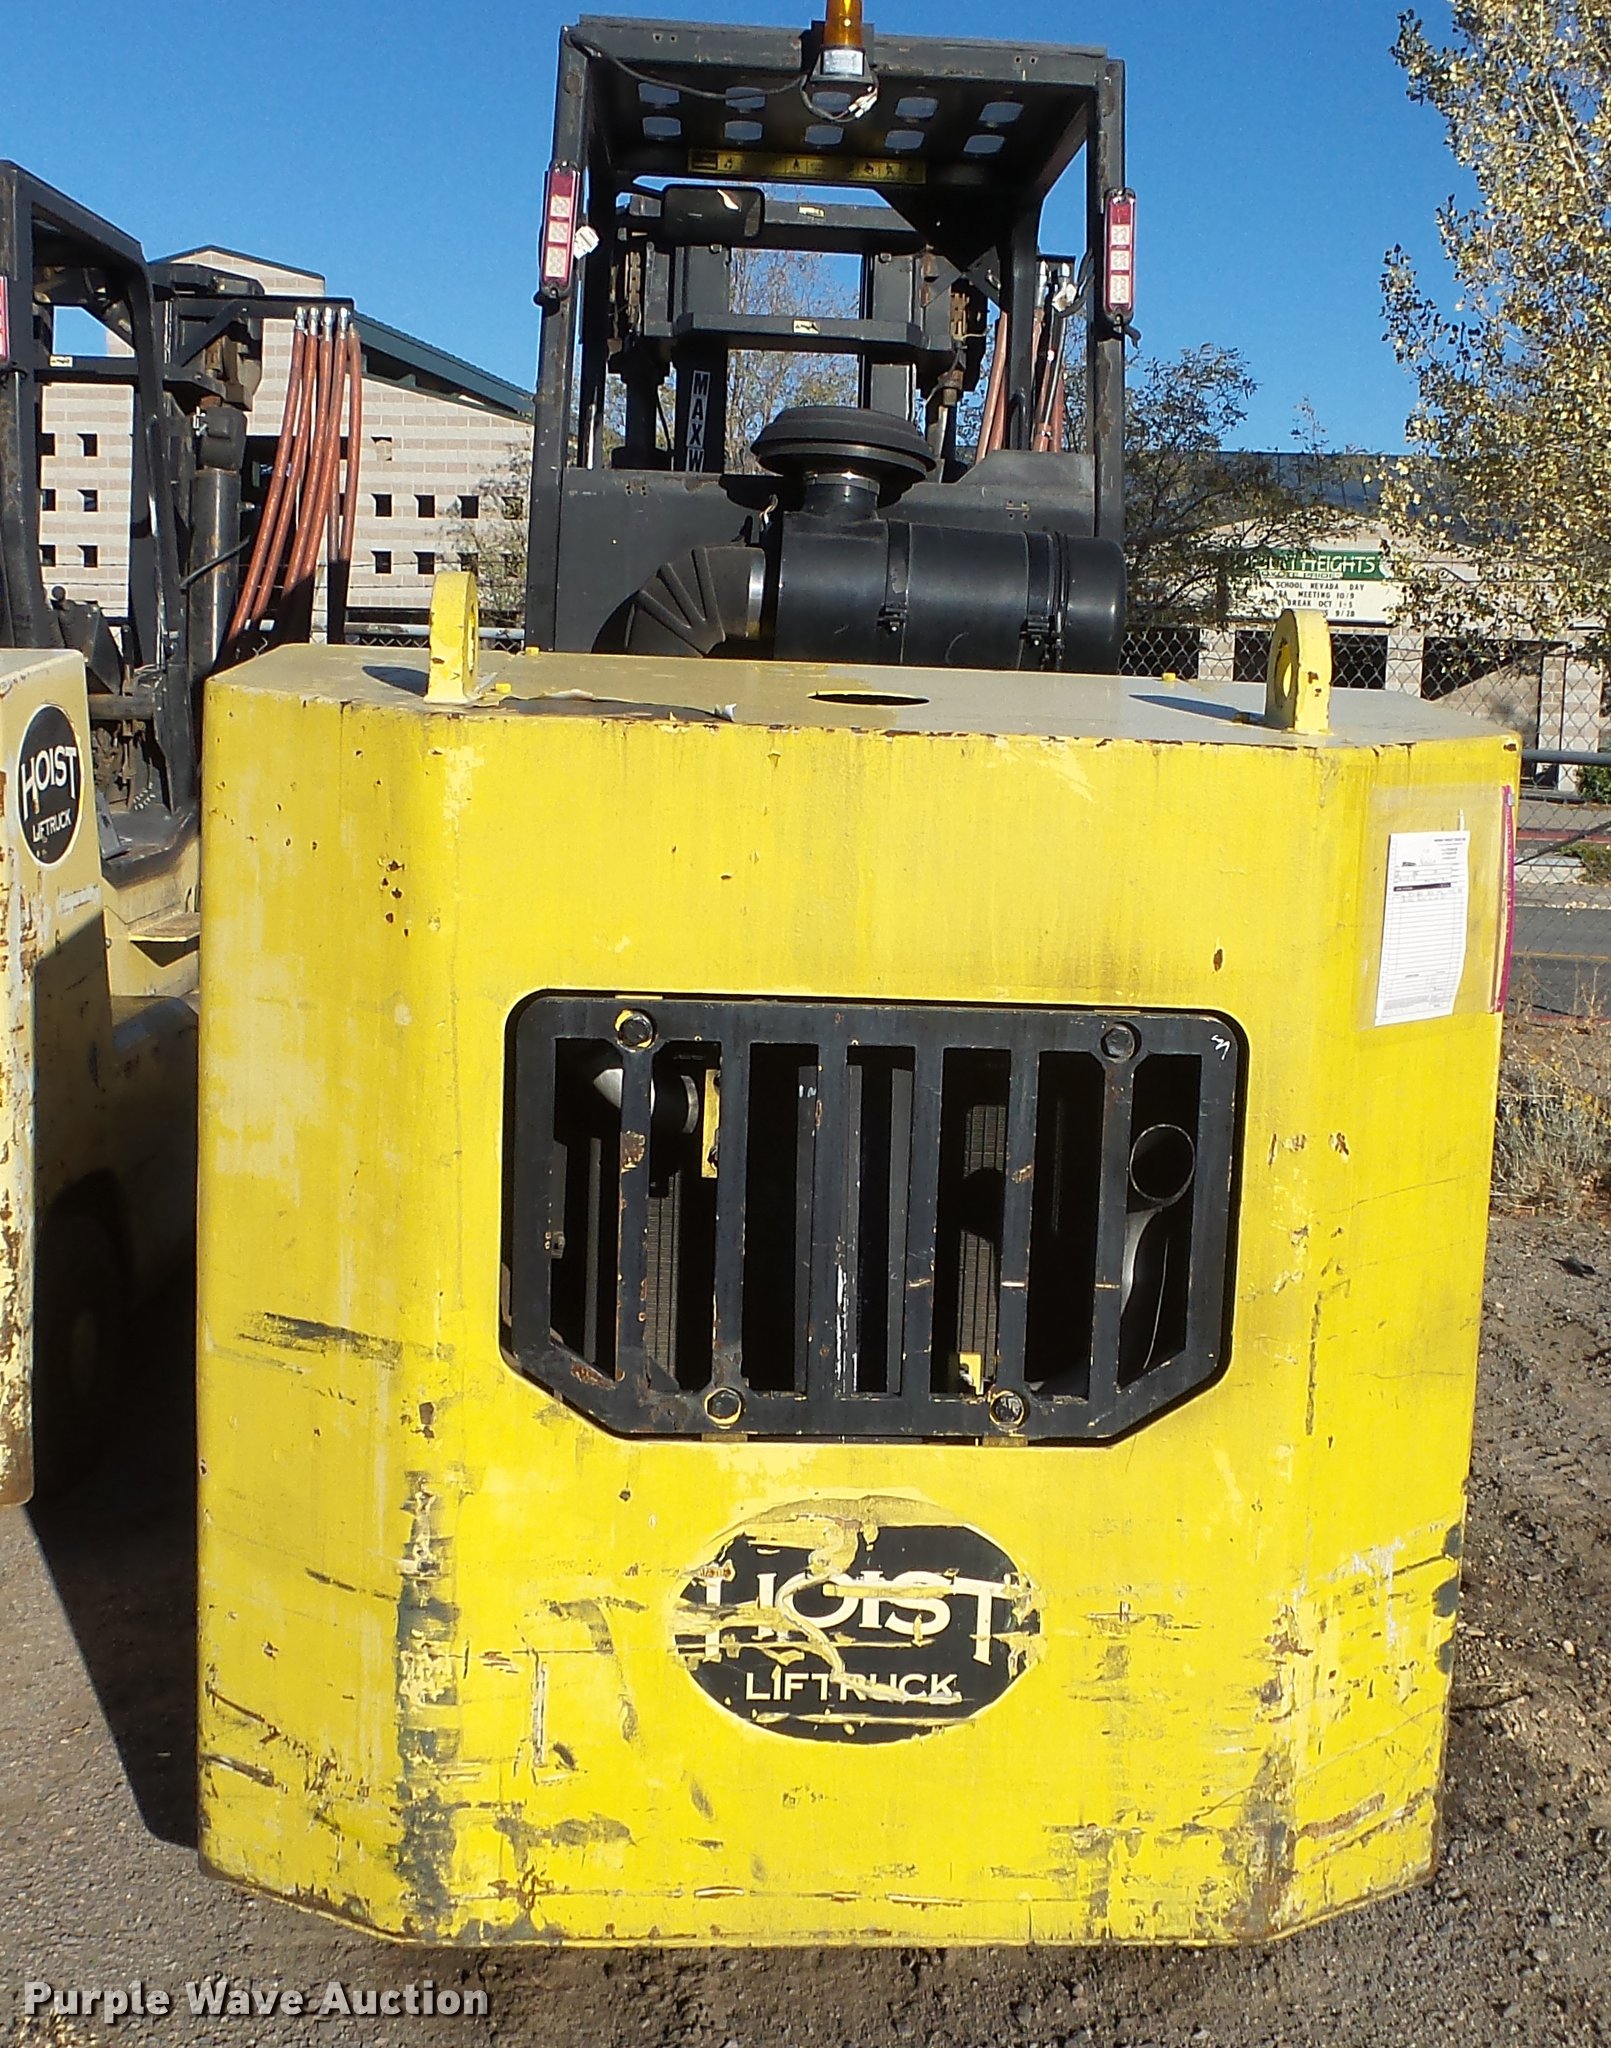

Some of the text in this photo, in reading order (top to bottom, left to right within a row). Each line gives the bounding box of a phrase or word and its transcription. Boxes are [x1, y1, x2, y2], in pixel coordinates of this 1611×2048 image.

[1300, 551, 1376, 573] HEIGHTS
[1275, 581, 1304, 589] SCHOOL
[1310, 582, 1339, 590] NEVADA
[1349, 583, 1365, 591] DAY
[1298, 591, 1331, 599] MEETING
[1336, 592, 1355, 600] 10/9
[1288, 599, 1312, 607] BREAK
[1318, 600, 1333, 608] OCT
[21, 745, 78, 822] HOIST
[32, 807, 72, 843] LIFTRUCK
[700, 1569, 1028, 1666] HOIST
